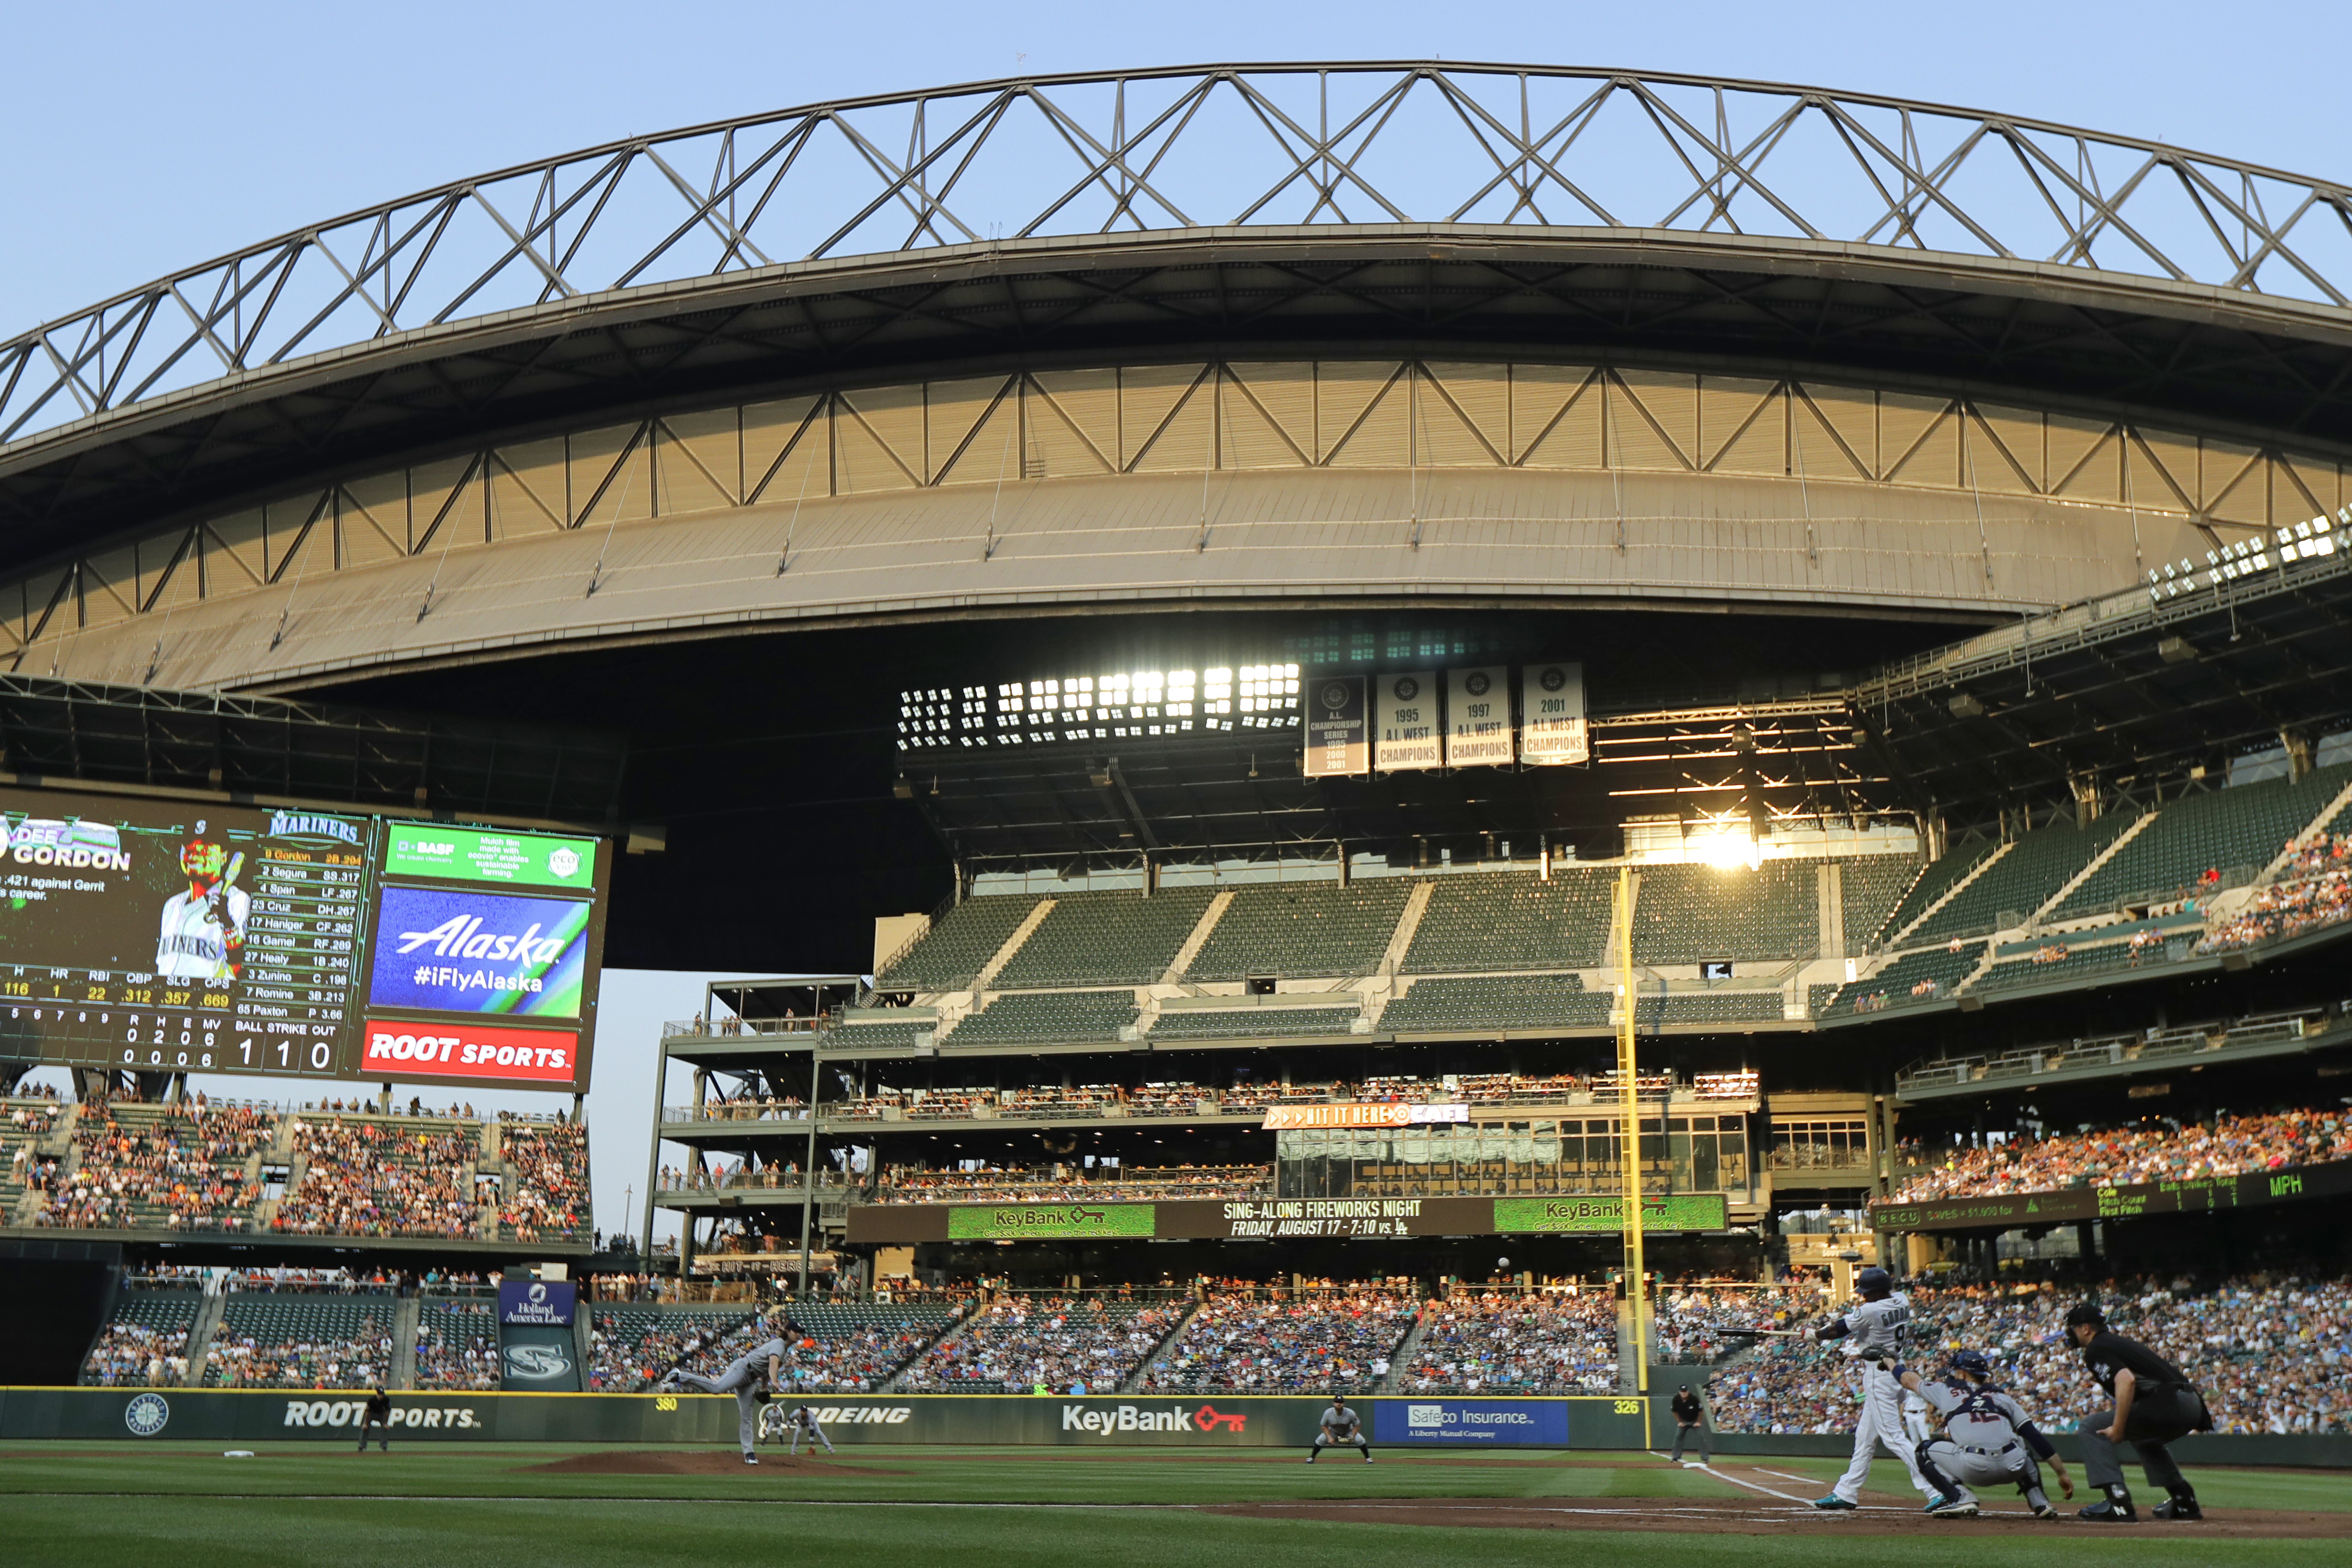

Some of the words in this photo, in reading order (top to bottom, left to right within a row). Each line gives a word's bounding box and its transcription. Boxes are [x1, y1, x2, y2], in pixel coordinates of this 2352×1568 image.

[1467, 704, 1490, 718] 1997
[1540, 698, 1565, 713] 2001
[1329, 711, 1343, 720] A.L.
[1395, 708, 1419, 723] 1995
[1310, 720, 1362, 731] CHAMPIONSHIP
[1458, 724, 1473, 738] A.L.
[1475, 721, 1502, 737] WEST
[1532, 718, 1548, 732] A.L.
[1550, 716, 1576, 731] WEST
[1324, 730, 1348, 740] SERIES
[1386, 729, 1402, 743] A.L.
[1403, 727, 1429, 741] WEST
[1326, 739, 1346, 749] 1995
[1452, 741, 1508, 759] CHAMPIONS
[1526, 735, 1582, 752] CHAMPIONS
[1326, 750, 1346, 759] 2000
[1380, 746, 1435, 763] CHAMPIONS
[1326, 760, 1346, 769] 2001
[18, 828, 58, 845] DEE
[268, 815, 358, 843] MARINERS
[417, 841, 455, 855] BASF
[480, 836, 504, 846] Mulch
[506, 838, 520, 847] film
[275, 849, 311, 863] Gordon
[479, 845, 501, 853] made
[503, 846, 519, 855] with
[14, 845, 131, 871] GORDON
[476, 860, 520, 870] sustainable
[499, 854, 530, 863] enables
[553, 854, 575, 864] eco
[263, 866, 270, 876] 2
[272, 866, 307, 879] Segura
[482, 867, 513, 879] farming.
[31, 877, 71, 890] against
[74, 879, 105, 892] Gerrit
[259, 883, 267, 893] 4
[270, 884, 296, 895] Span
[322, 887, 335, 898] LF
[336, 889, 358, 899] .267
[9, 889, 47, 900] career.
[251, 899, 265, 910] 23
[267, 900, 291, 912] Cruz
[250, 917, 263, 928] 17
[265, 918, 304, 932] Haniger
[316, 922, 331, 932] CF
[248, 934, 260, 945] 16
[263, 935, 296, 947] Gamel
[314, 939, 329, 949] RF
[396, 914, 566, 968] Alaska
[244, 951, 258, 962] 27
[260, 952, 290, 966] Healy
[313, 956, 326, 967] 1B
[327, 957, 349, 968] .240
[14, 966, 24, 976] H
[50, 968, 68, 979] HR
[88, 970, 110, 982] RBI
[126, 972, 152, 984] OBP
[166, 975, 190, 987] SLG
[205, 977, 230, 989] OPS
[248, 969, 255, 980] 3
[257, 970, 292, 982] Zunino
[313, 973, 321, 984] C
[414, 966, 543, 992] #iFlyAlaska
[5, 982, 30, 996] 116
[53, 984, 60, 998] 1
[88, 986, 106, 1000] 22
[121, 989, 151, 1003] .312
[160, 991, 191, 1005] .357
[199, 993, 229, 1008] .669
[246, 987, 253, 997] 7
[255, 987, 294, 1000] Romine
[308, 991, 321, 1001] 3B
[323, 992, 344, 1003] .213
[11, 1007, 19, 1019] 5
[33, 1009, 42, 1020] 6
[57, 1010, 65, 1021] 7
[78, 1011, 86, 1022] 8
[101, 1013, 109, 1024] 9
[130, 1014, 139, 1026] R
[157, 1016, 166, 1027] H
[184, 1017, 192, 1029] E
[203, 1019, 221, 1030] MV
[237, 1004, 250, 1014] 65
[253, 1005, 288, 1017] Paxton
[308, 1008, 317, 1018] P
[322, 1009, 342, 1020] 3.66
[235, 1020, 263, 1033] BALL
[267, 1022, 307, 1035] STRIKE
[312, 1025, 336, 1037] OUT
[127, 1028, 138, 1042] 0
[153, 1029, 165, 1044] 2
[181, 1031, 190, 1046] 0
[204, 1032, 214, 1047] 6
[123, 1049, 134, 1064] 0
[151, 1050, 161, 1065] 0
[177, 1052, 187, 1066] 0
[201, 1053, 212, 1068] 6
[239, 1038, 252, 1065] 1
[277, 1040, 290, 1067] 1
[311, 1042, 330, 1069] 0
[369, 1033, 461, 1063] ROOT
[460, 1043, 567, 1070] SPORTS
[1306, 1108, 1329, 1125] HIT
[1334, 1107, 1349, 1125] IT
[1355, 1106, 1389, 1124] HERE
[1410, 1104, 1470, 1123] CAFE
[2269, 1173, 2303, 1198] MPH
[1223, 1202, 1302, 1220] SING-ALONG
[1306, 1201, 1380, 1218] FIREWORKS
[1383, 1200, 1422, 1217] NIGHT
[1545, 1202, 1624, 1221] KeyBank
[994, 1210, 1067, 1228] KeyBank
[1880, 1212, 1917, 1224] BECU
[1019, 1230, 1040, 1238] when
[1231, 1220, 1274, 1237] FRIDAY,
[1277, 1220, 1325, 1236] AUGUST
[1327, 1220, 1341, 1235] 17
[1350, 1219, 1377, 1234] 7:10
[1533, 1222, 1549, 1230] Get
[1573, 1222, 1595, 1230] when
[1597, 1223, 1613, 1231] you
[517, 1302, 554, 1315] Holland
[505, 1311, 544, 1324] America
[544, 1312, 565, 1324] Line
[1895, 1325, 1905, 1351] 9
[655, 1397, 678, 1411] 380
[1614, 1400, 1640, 1414] 326
[284, 1401, 368, 1426] ROOT
[370, 1407, 474, 1428] PORTS
[1063, 1405, 1194, 1435] KeyBank
[1412, 1409, 1458, 1424] Safeco
[1463, 1409, 1527, 1424] Insurance
